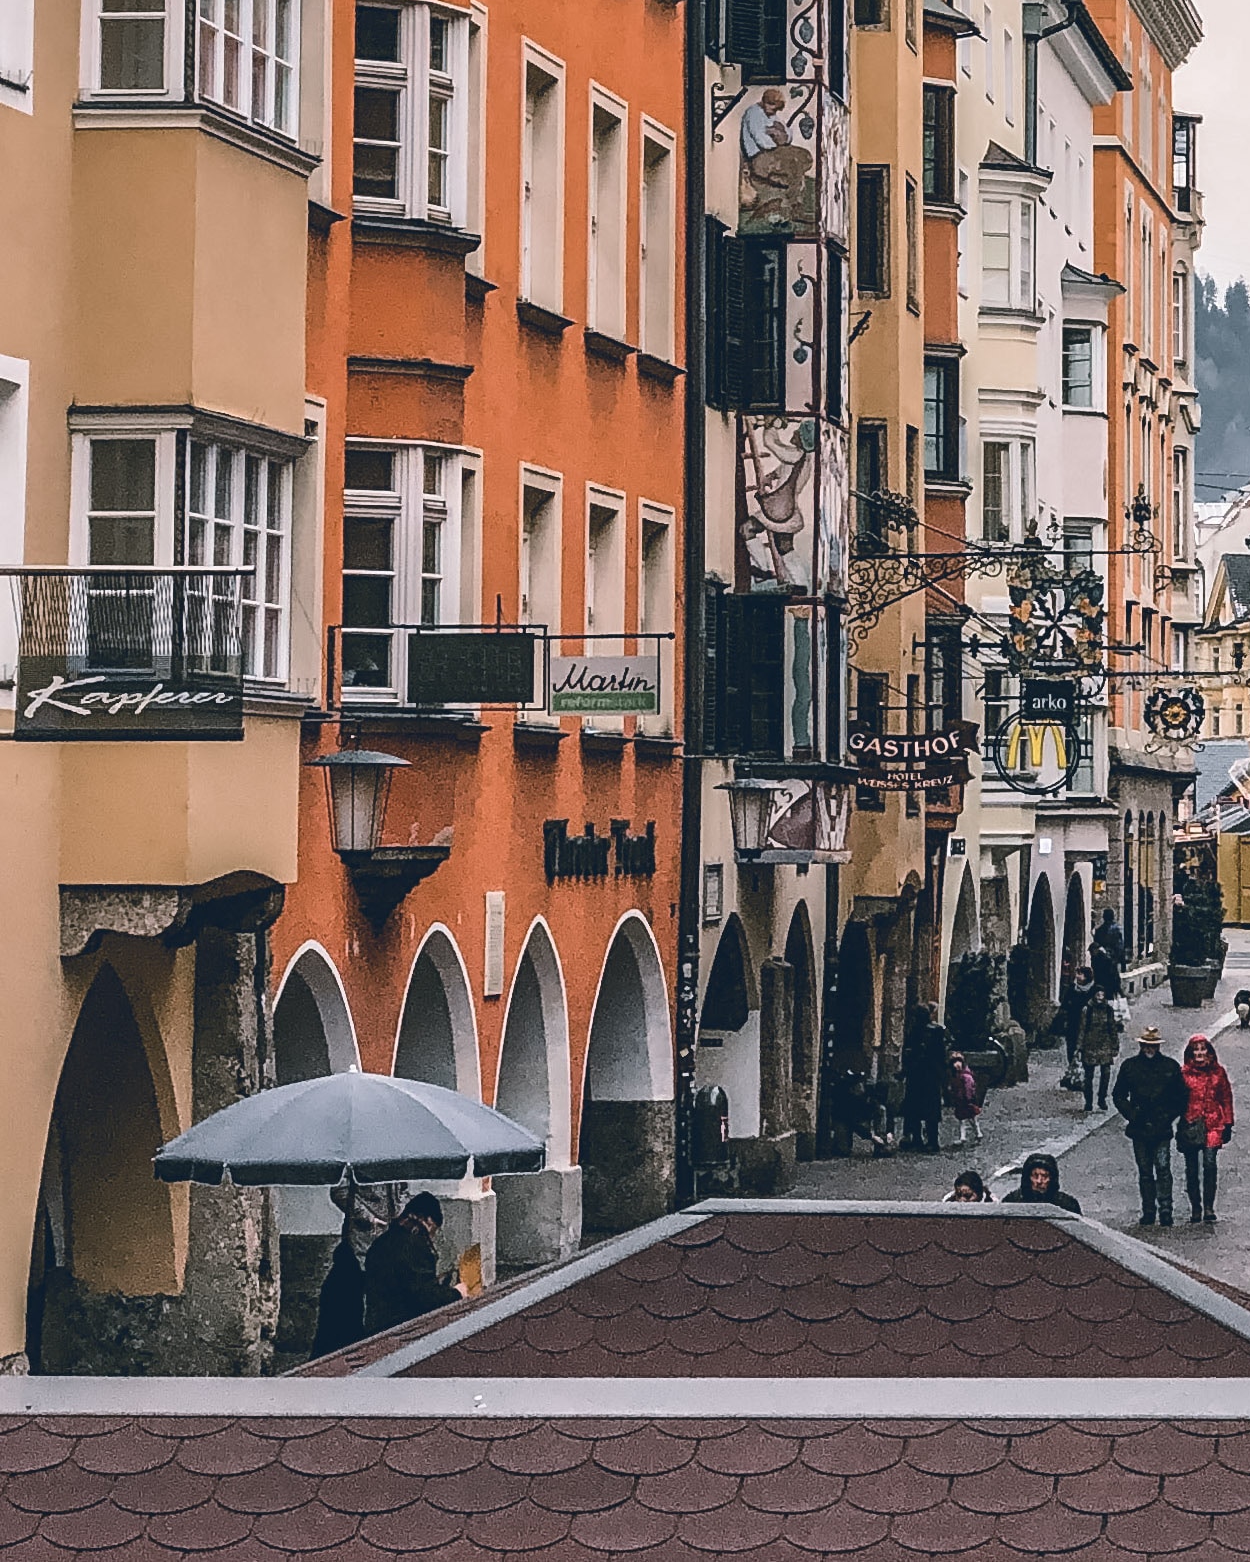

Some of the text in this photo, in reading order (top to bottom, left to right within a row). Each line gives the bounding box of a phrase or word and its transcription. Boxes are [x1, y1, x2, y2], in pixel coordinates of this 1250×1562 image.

[553, 663, 655, 693] Martin
[23, 675, 234, 718] Kapferer
[1032, 693, 1067, 711] arko
[849, 730, 960, 757] GASTHOF
[887, 772, 923, 781] HOTEL
[914, 774, 953, 788] KREUZ
